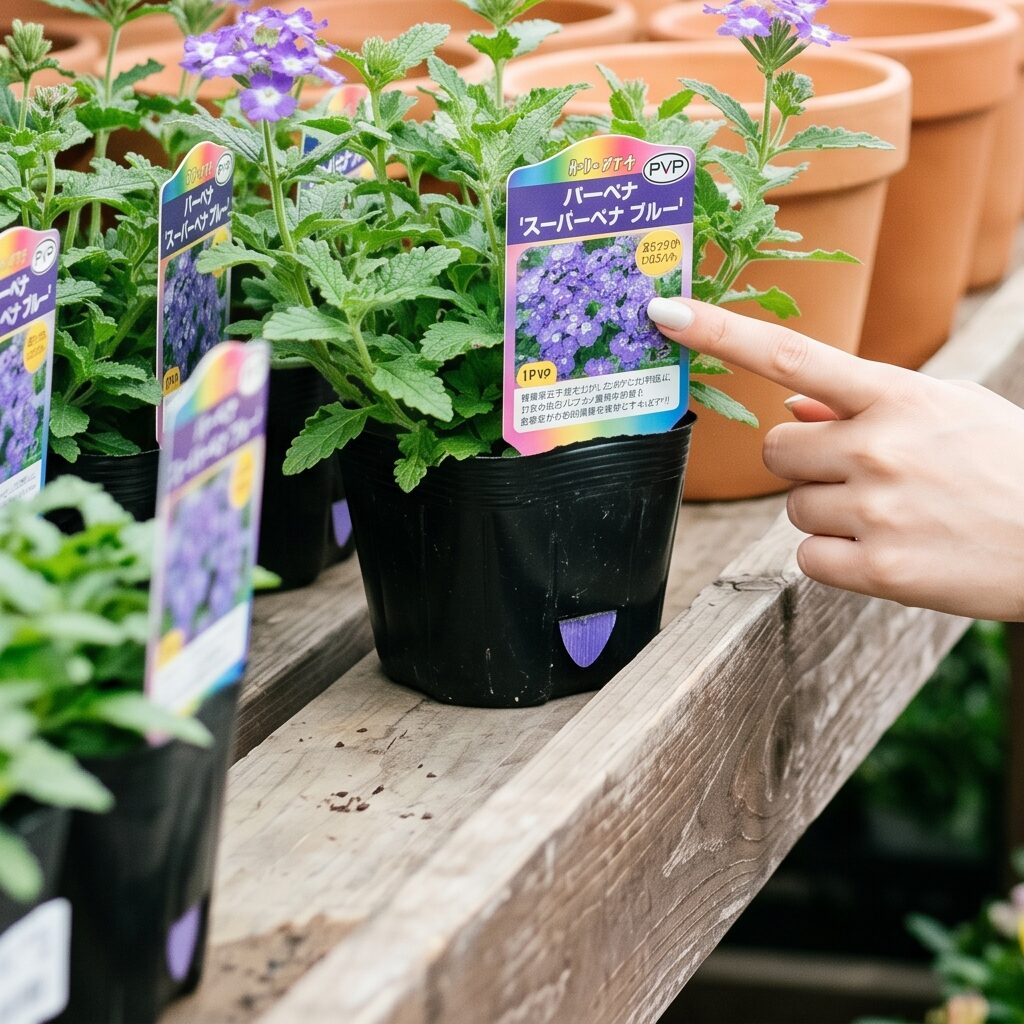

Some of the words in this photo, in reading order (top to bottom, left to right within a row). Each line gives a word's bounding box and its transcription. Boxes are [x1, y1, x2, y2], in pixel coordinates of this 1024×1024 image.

[649, 159, 684, 176] PVP
[563, 181, 639, 207] バーベナ
